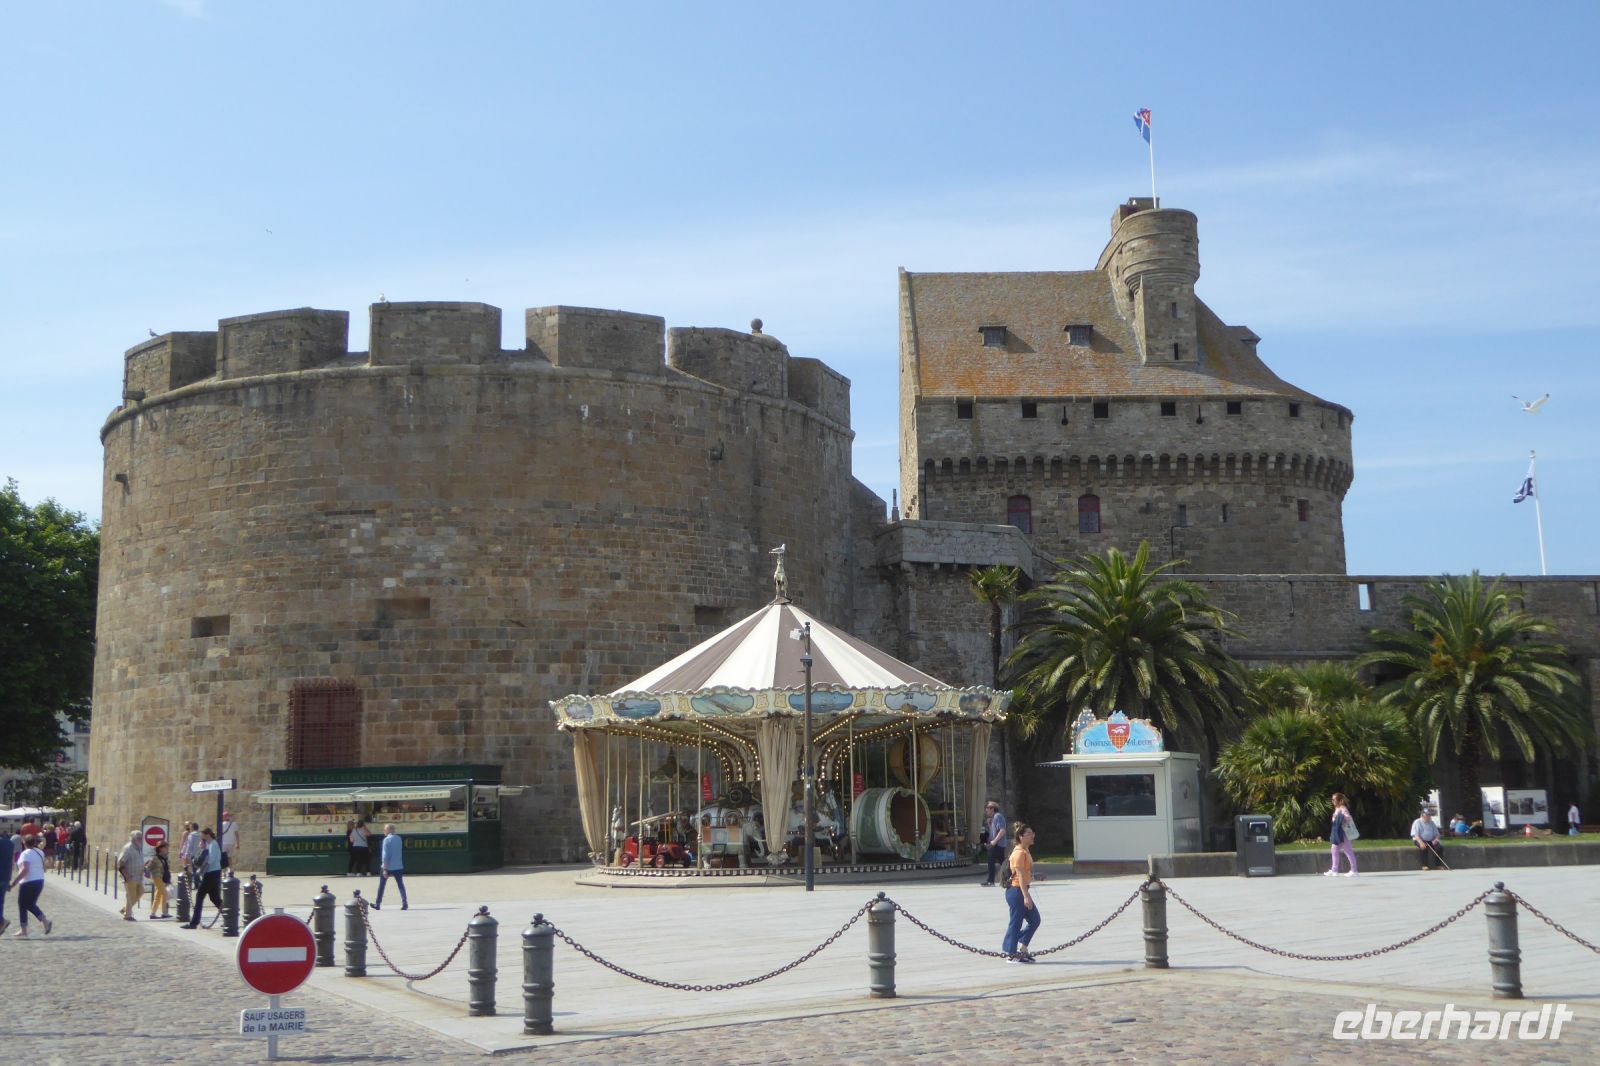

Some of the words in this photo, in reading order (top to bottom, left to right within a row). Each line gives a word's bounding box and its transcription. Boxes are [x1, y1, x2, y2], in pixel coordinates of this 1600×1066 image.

[244, 1012, 265, 1021] SAUF
[268, 1011, 304, 1020] USAGERS
[244, 1024, 255, 1032] de
[258, 1024, 266, 1032] la
[269, 1021, 304, 1031] MAIRIE
